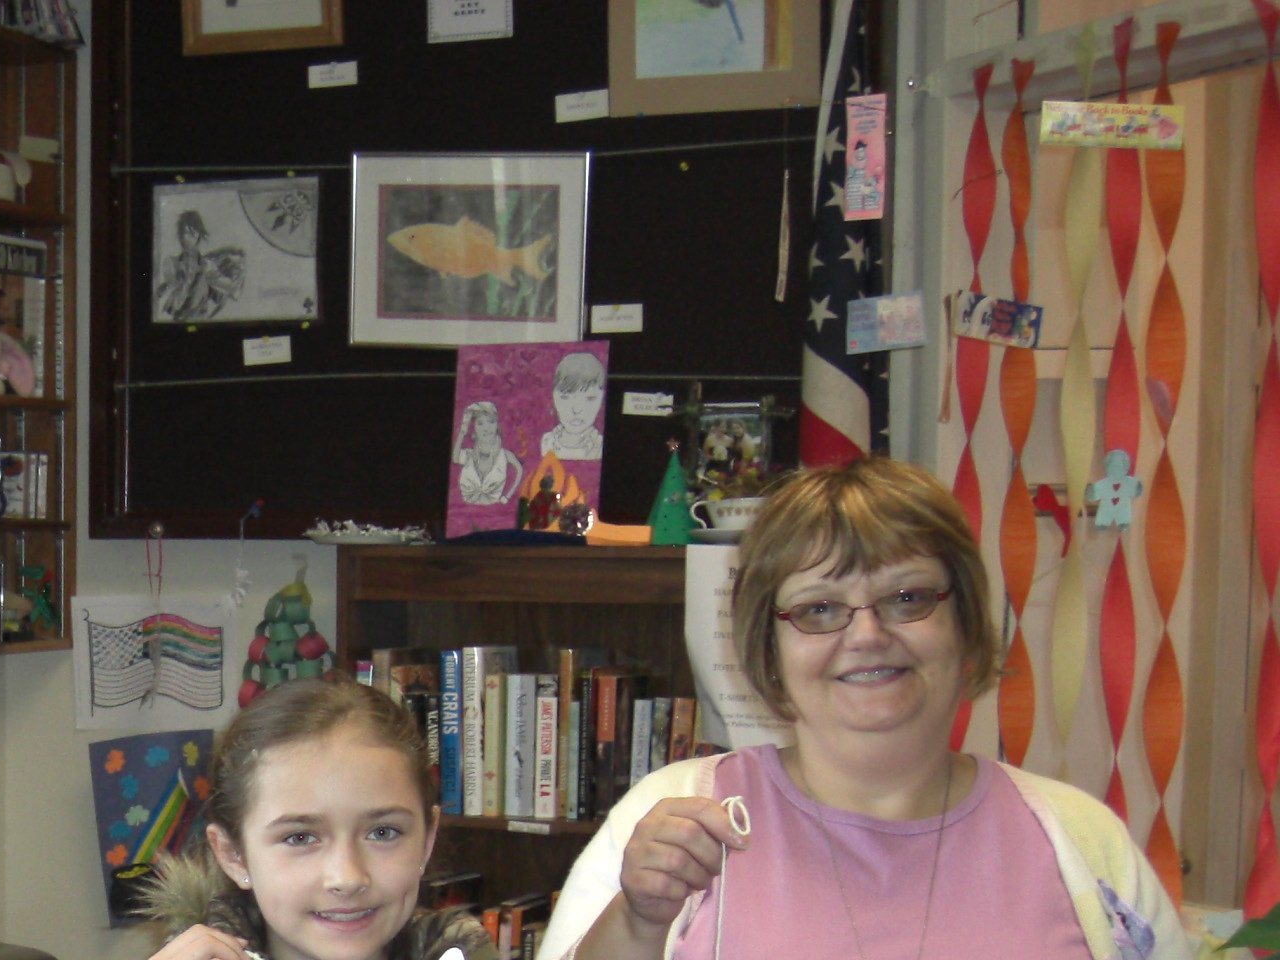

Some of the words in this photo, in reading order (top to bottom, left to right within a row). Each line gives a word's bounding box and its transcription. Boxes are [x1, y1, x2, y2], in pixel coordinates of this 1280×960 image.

[444, 655, 456, 689] ROBERT
[442, 691, 459, 735] CRAIS
[464, 722, 476, 759] ROBERT
[463, 761, 476, 797] HARRIS
